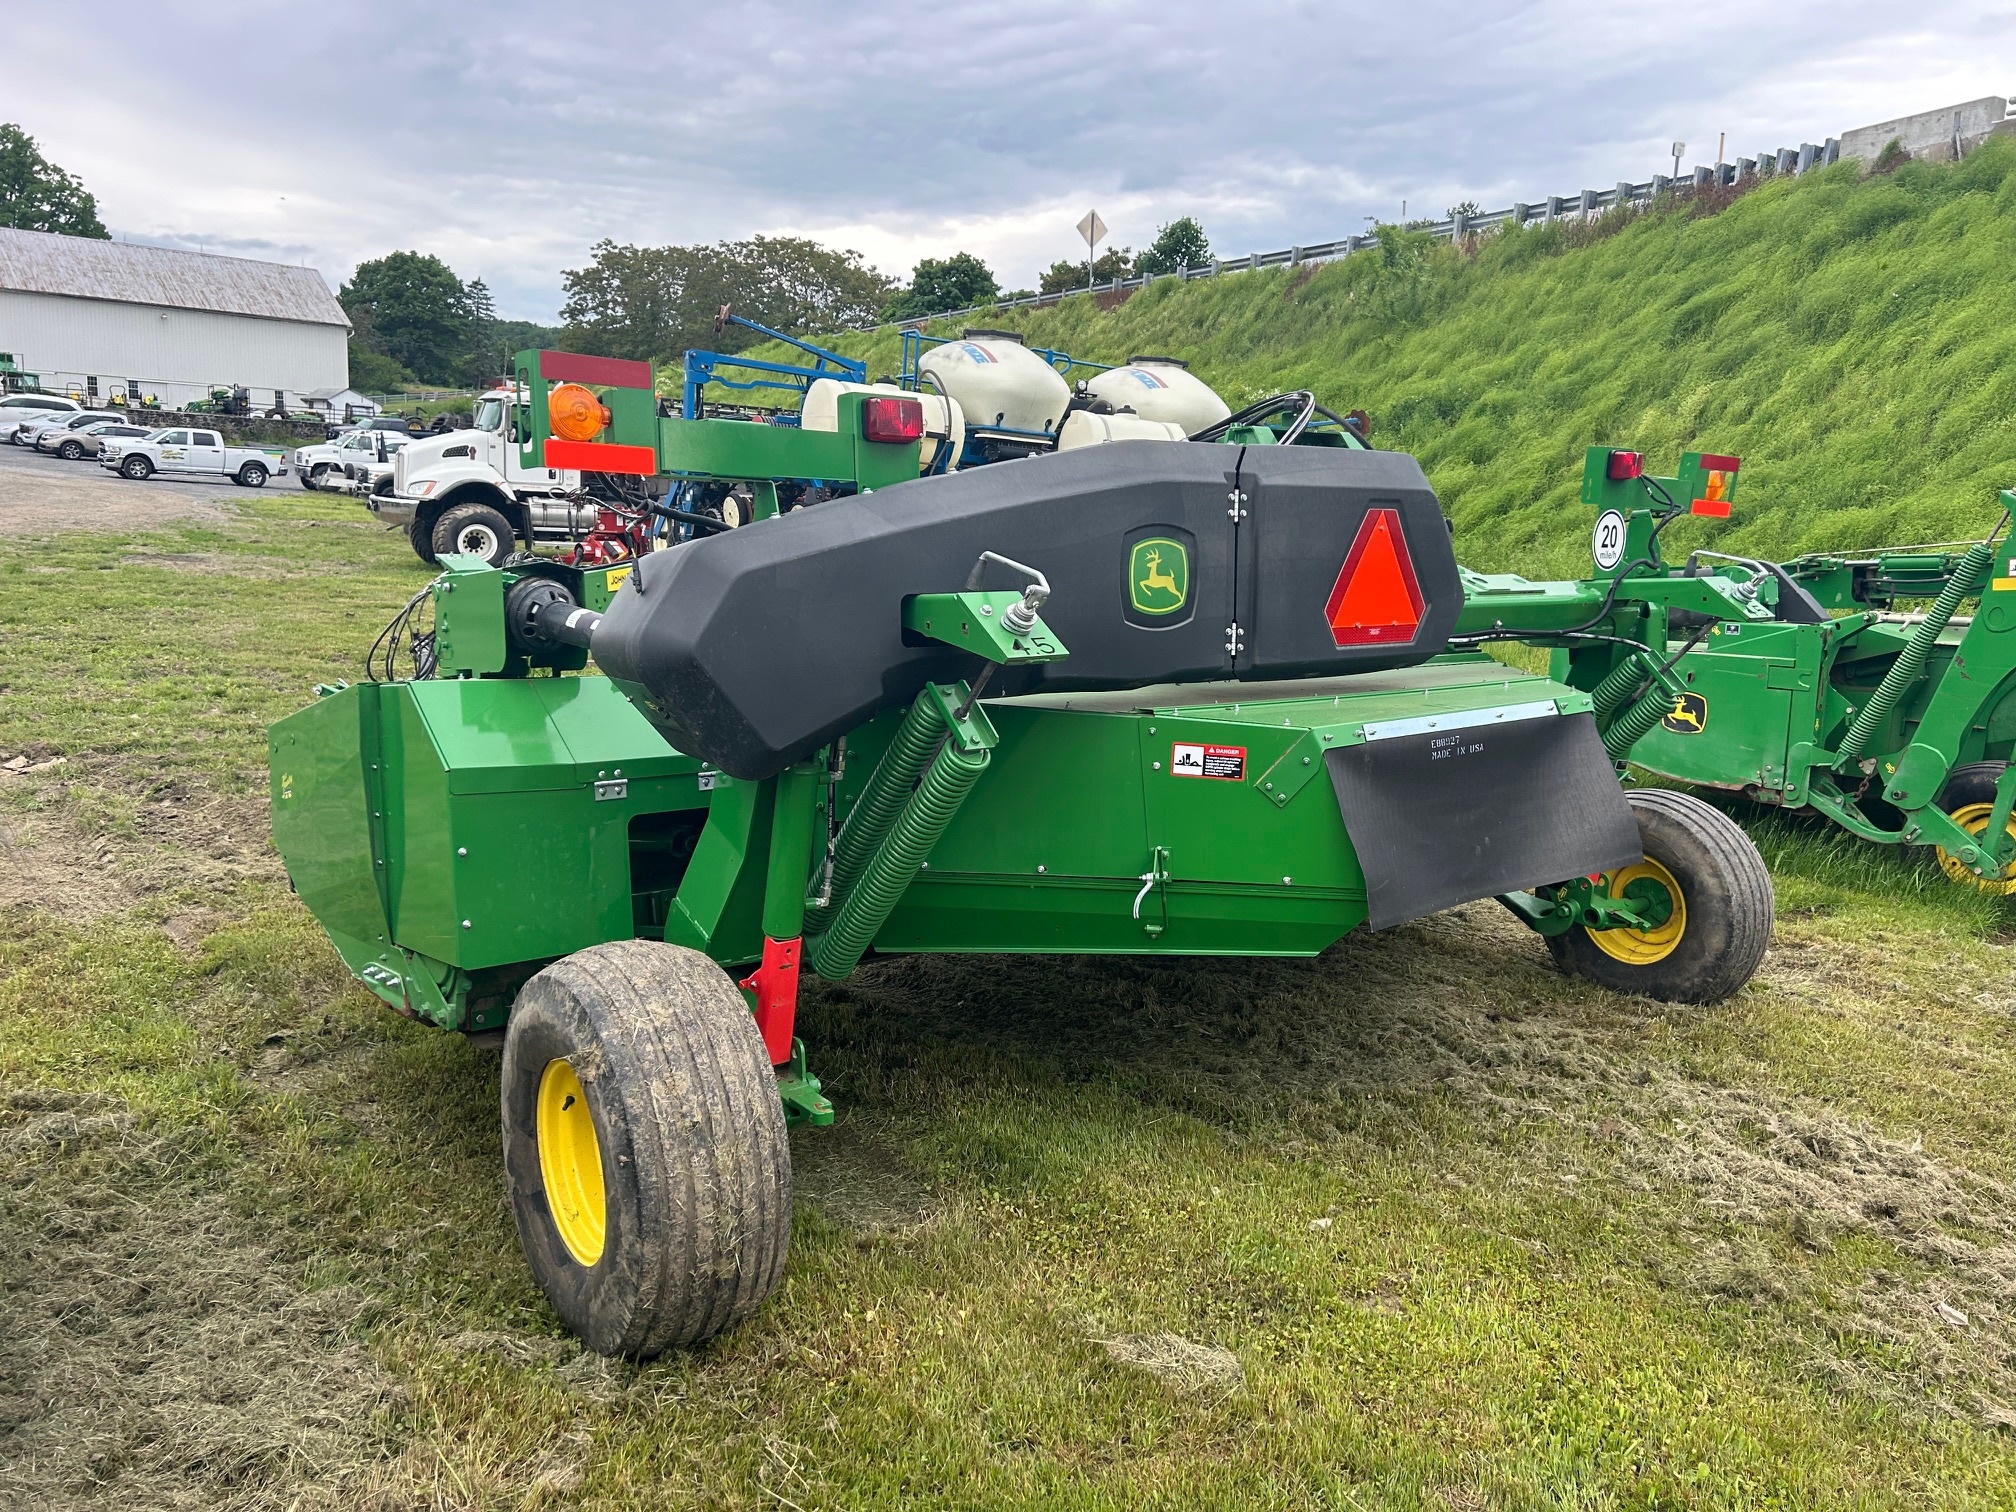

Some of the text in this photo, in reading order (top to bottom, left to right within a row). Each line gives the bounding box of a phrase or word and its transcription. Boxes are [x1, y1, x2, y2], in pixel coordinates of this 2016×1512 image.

[1601, 524, 1617, 548] 20
[1012, 637, 1055, 656] 4.5
[1431, 735, 1460, 749] E88927
[1432, 743, 1484, 760] MADE IN USA
